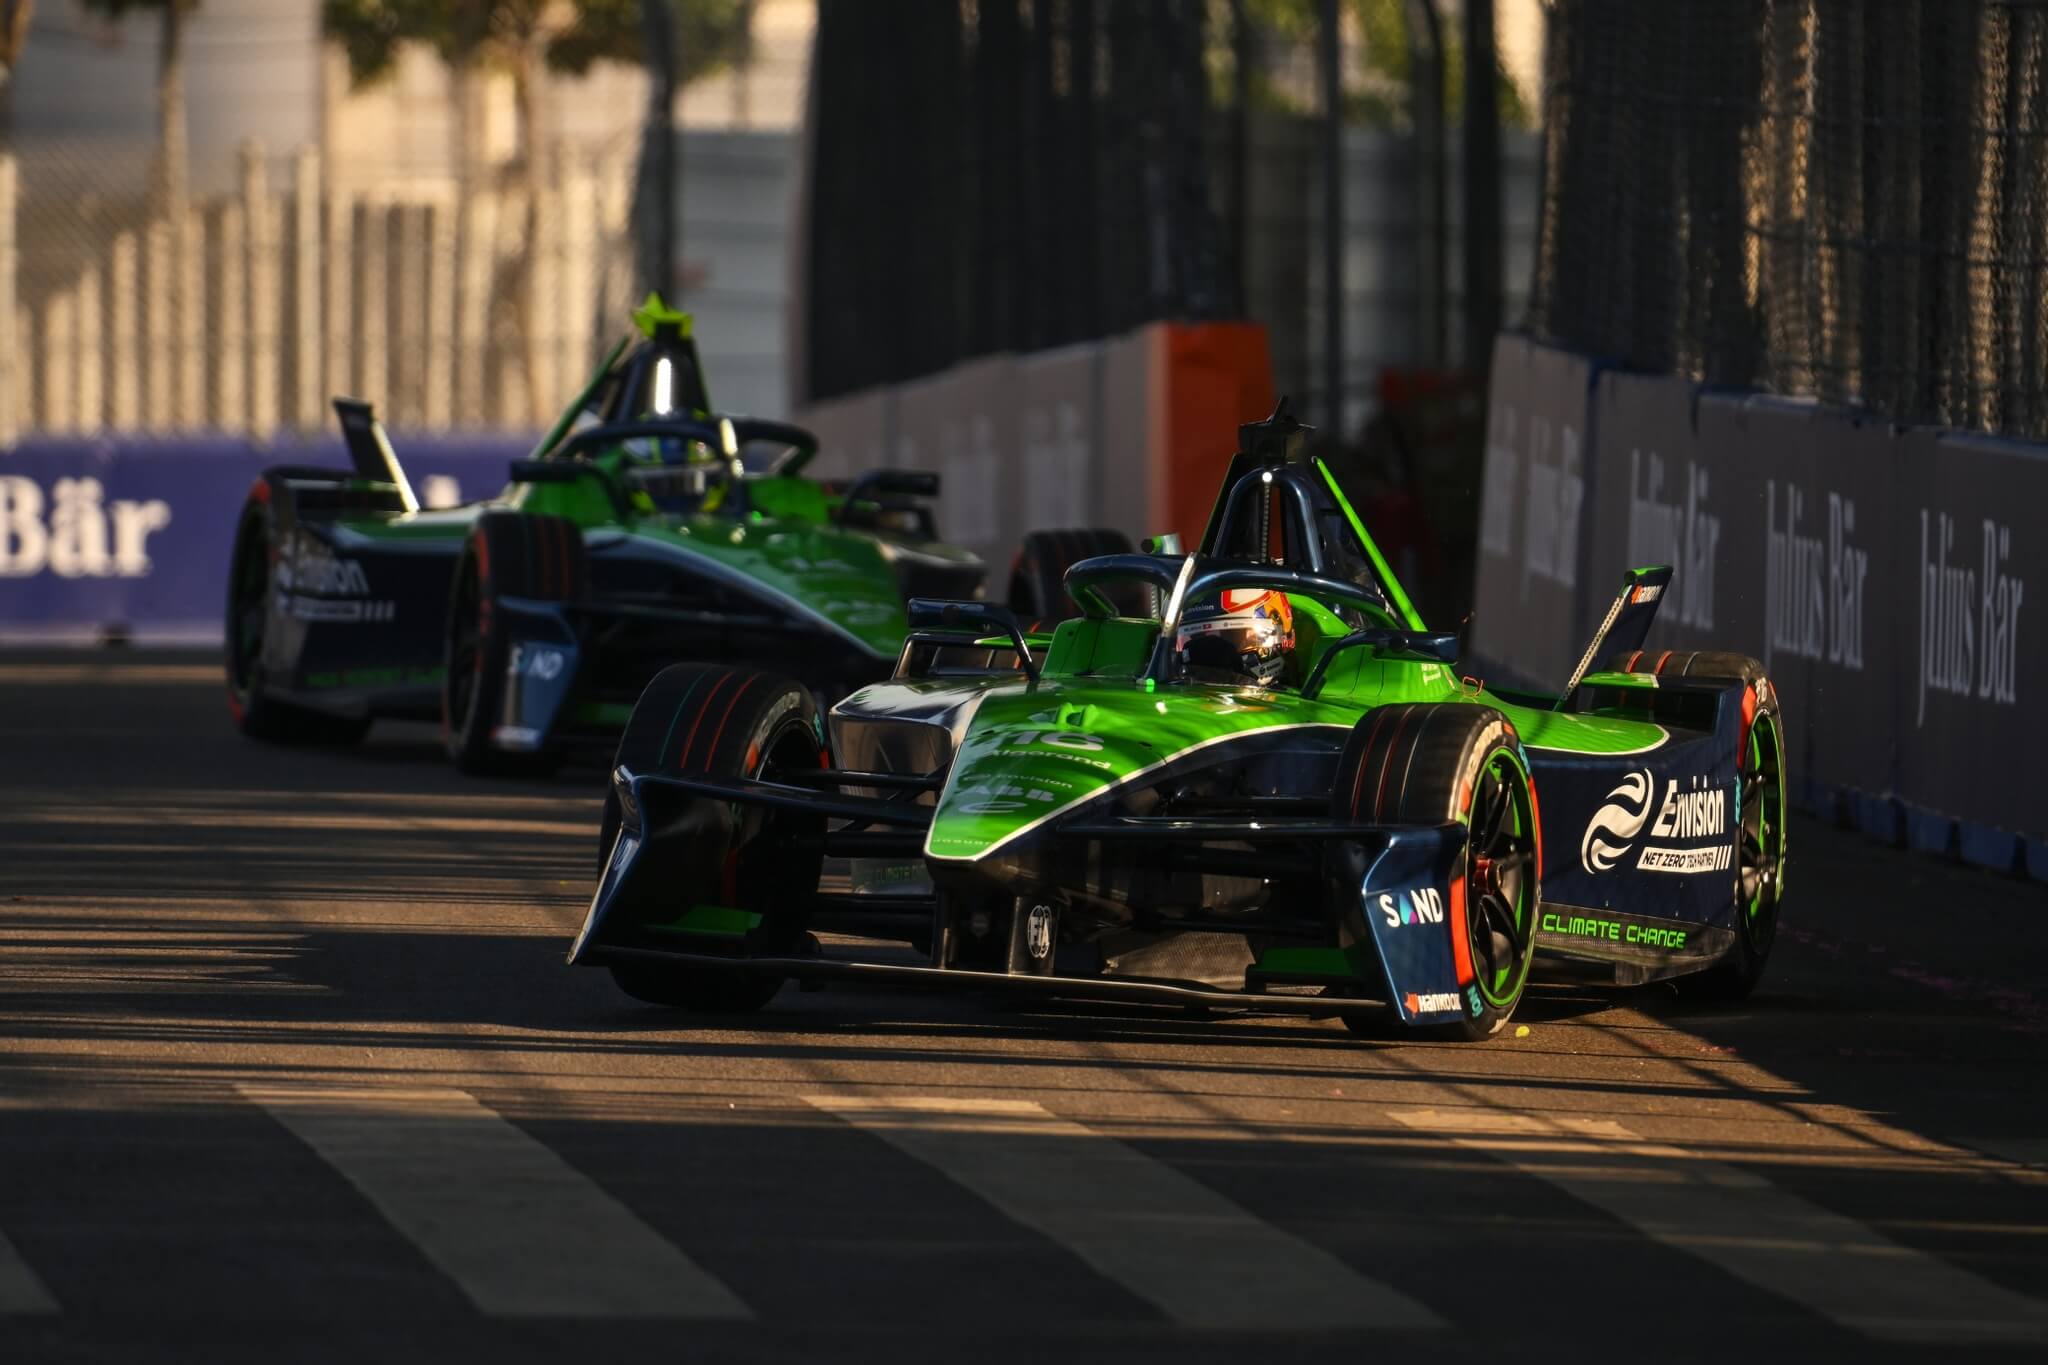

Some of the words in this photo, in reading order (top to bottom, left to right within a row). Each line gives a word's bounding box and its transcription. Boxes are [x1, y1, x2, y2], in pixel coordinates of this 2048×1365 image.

[0, 474, 172, 579] Bär
[1764, 479, 1825, 678] Julius
[1828, 491, 1868, 671] Bär
[1917, 507, 1976, 728] Julius
[1978, 516, 2024, 704] Bär
[1650, 779, 1725, 838] Envision
[1642, 850, 1663, 866] NET
[1662, 852, 1686, 868] ZERO
[1542, 913, 1621, 941] CLIMATE
[1626, 924, 1686, 949] CHANGE
